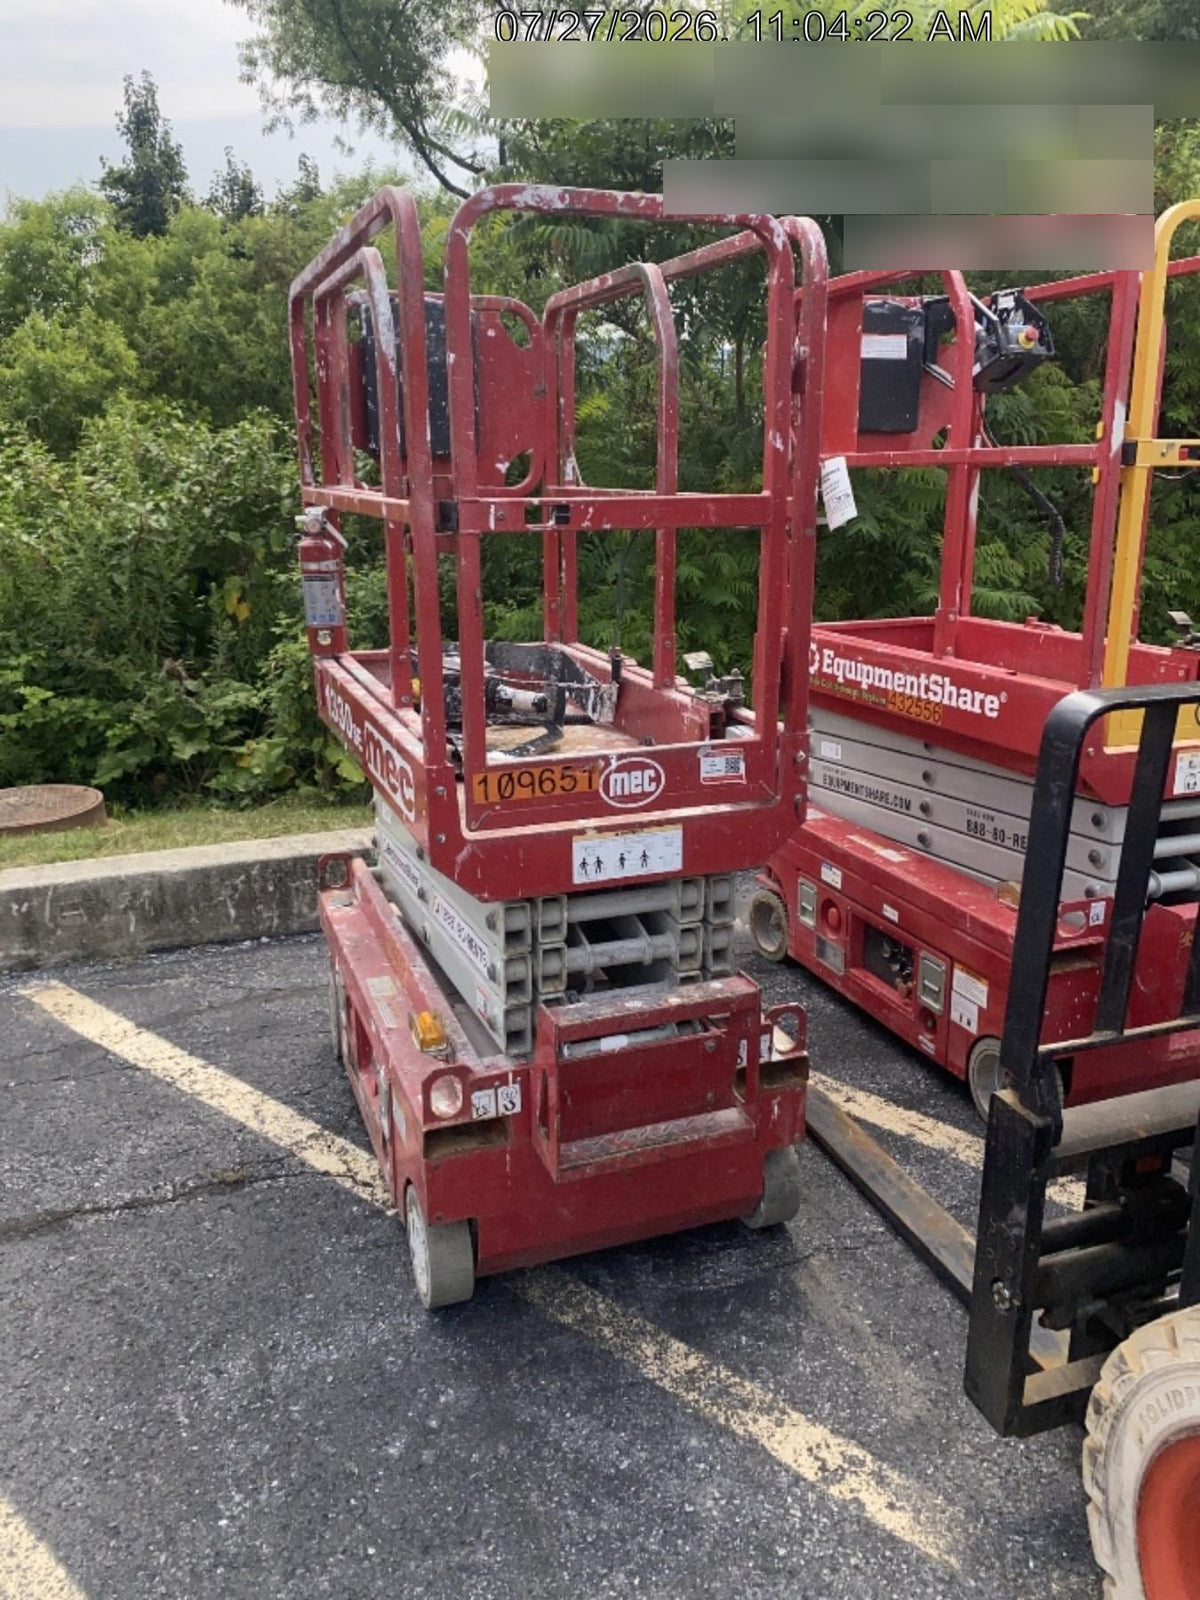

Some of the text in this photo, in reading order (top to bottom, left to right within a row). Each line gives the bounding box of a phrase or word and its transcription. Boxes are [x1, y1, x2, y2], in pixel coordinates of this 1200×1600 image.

[888, 692, 942, 724] 432556
[477, 766, 594, 801] 109651
[608, 769, 657, 798] mec
